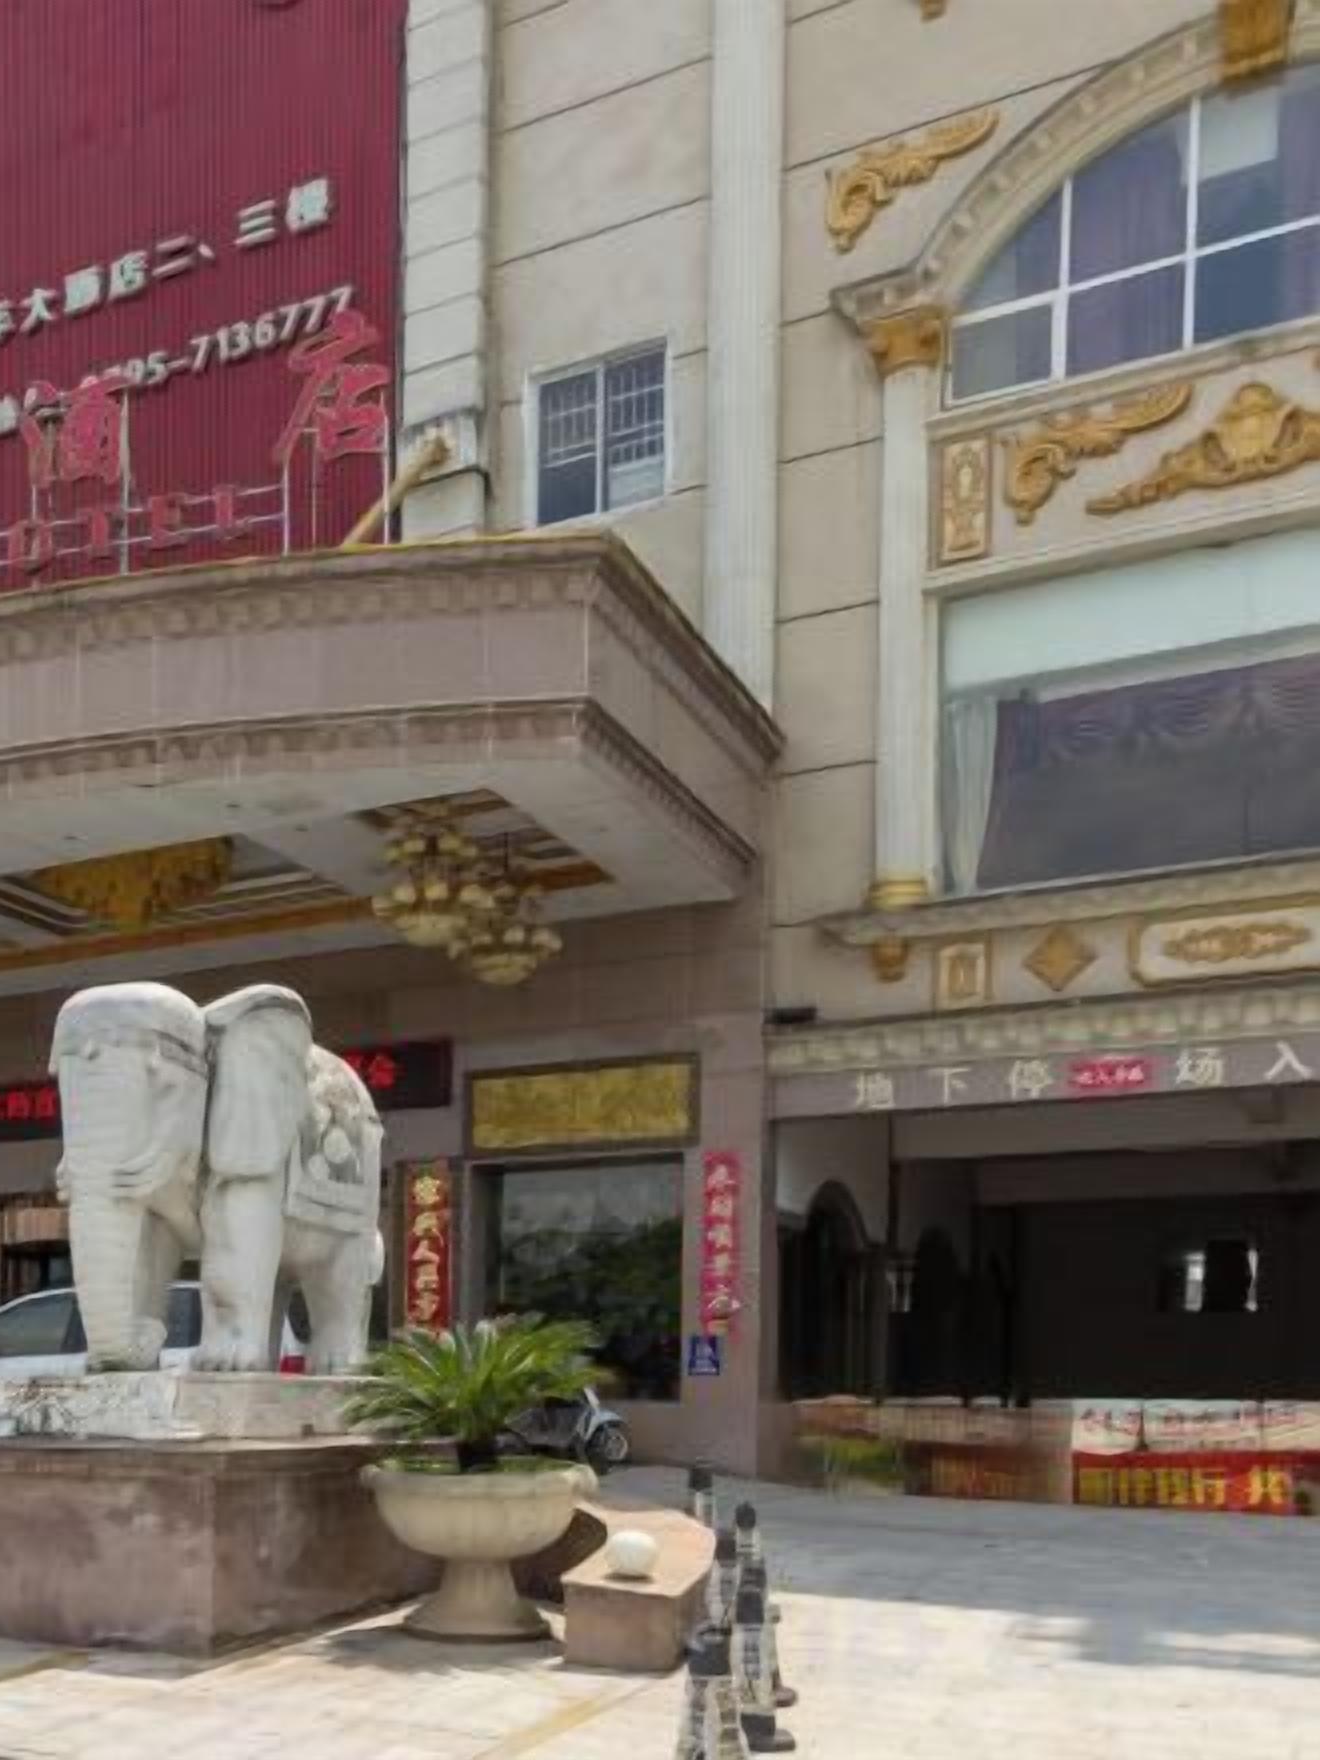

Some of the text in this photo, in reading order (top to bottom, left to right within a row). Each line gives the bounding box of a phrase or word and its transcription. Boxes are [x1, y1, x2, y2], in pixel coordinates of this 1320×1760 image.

[856, 1042, 1312, 1109] 地下停场入
